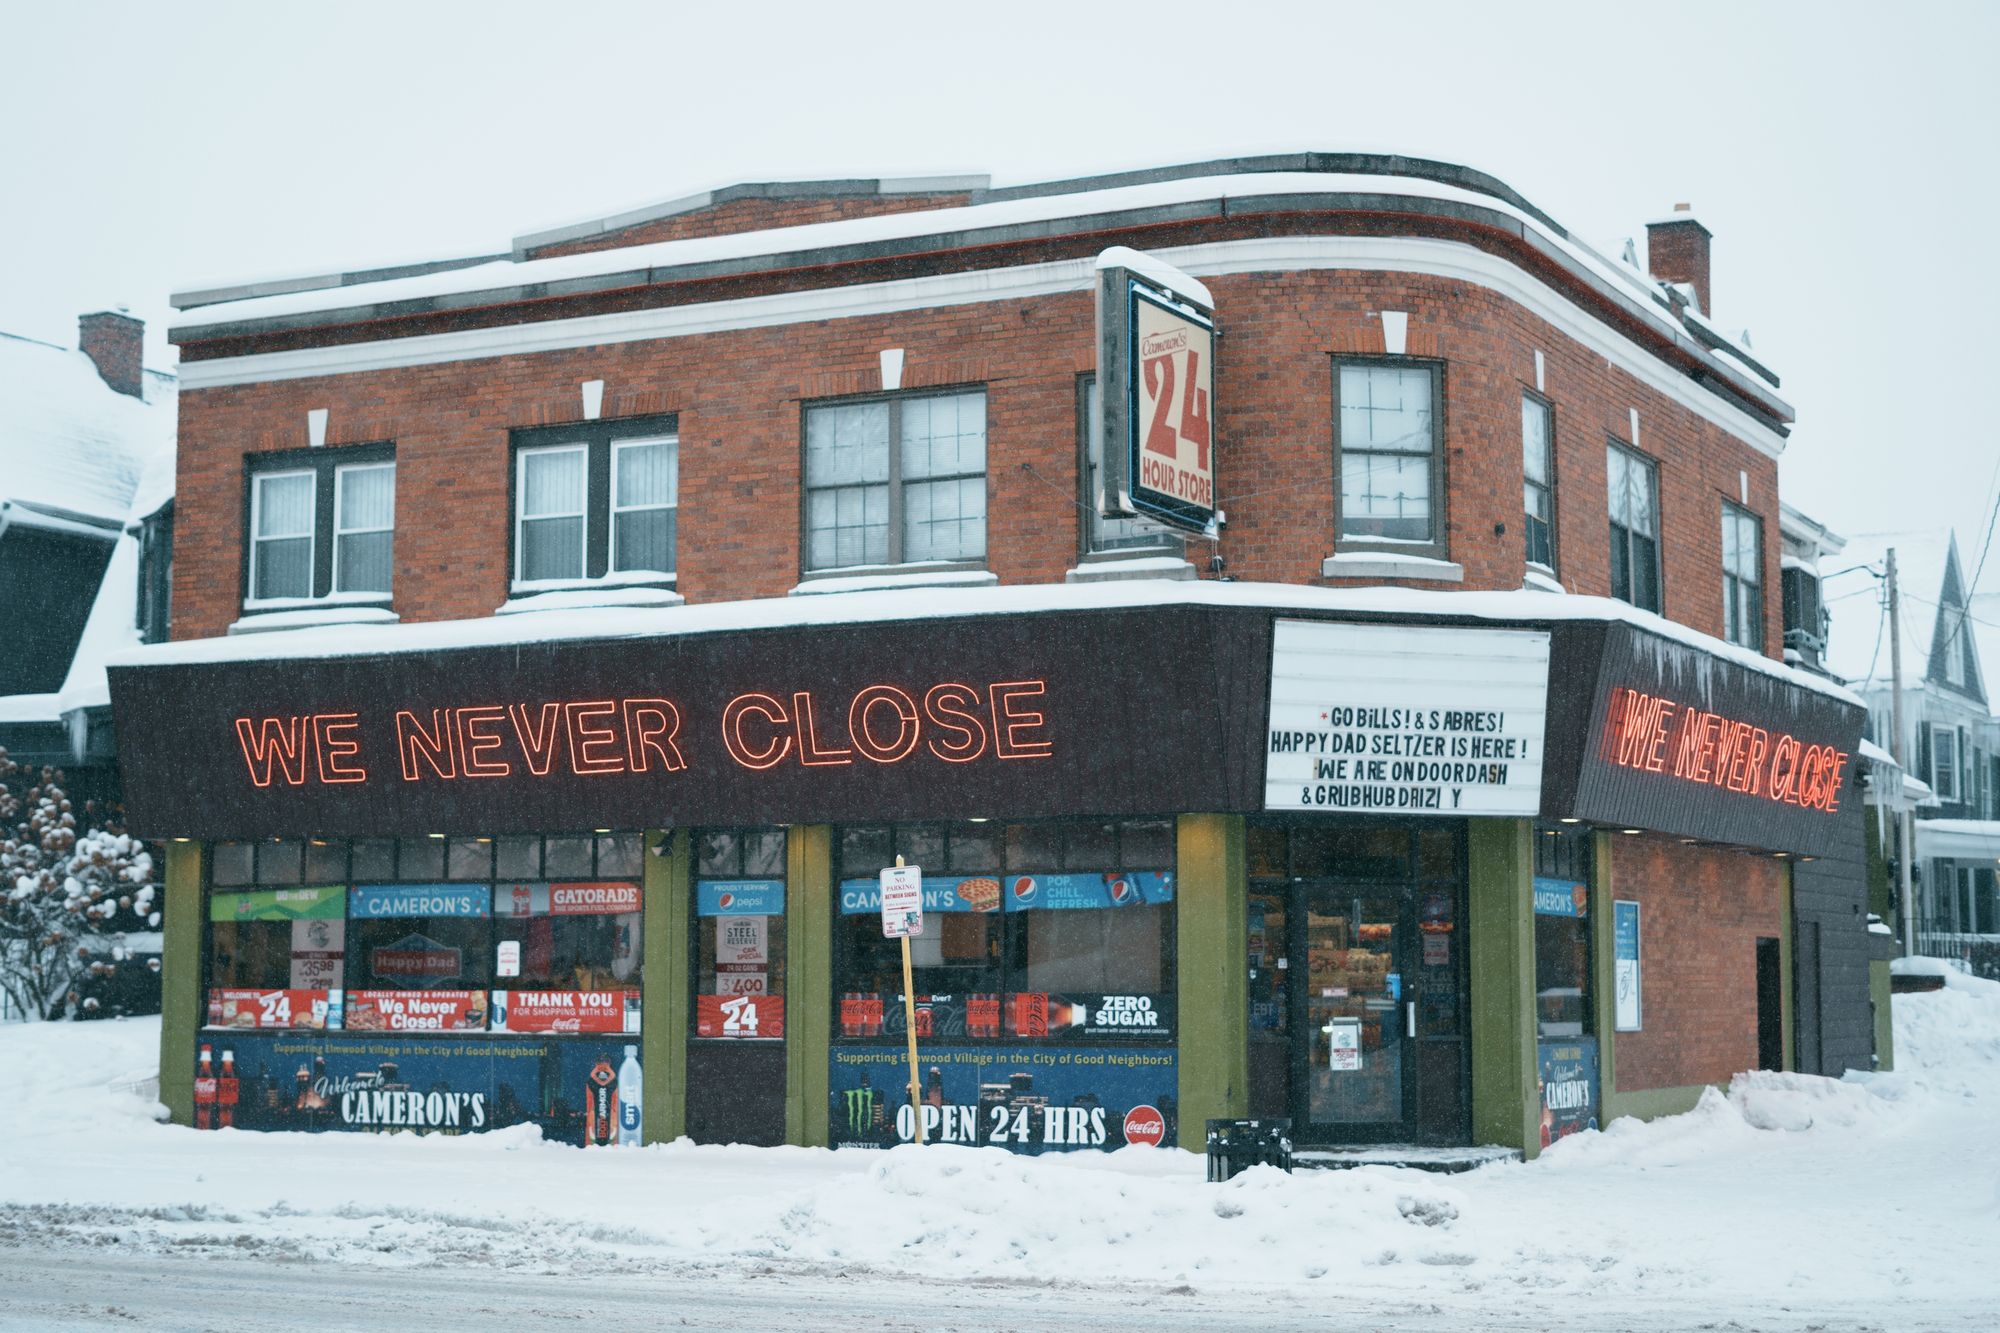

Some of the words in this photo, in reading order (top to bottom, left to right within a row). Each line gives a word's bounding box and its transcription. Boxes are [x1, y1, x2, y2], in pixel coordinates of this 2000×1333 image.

[1142, 332, 1187, 356] Cameron's
[1143, 349, 1210, 472] 24
[1143, 457, 1175, 494] HOUR
[1178, 470, 1211, 505] STORE
[1331, 707, 1354, 727] GO
[1414, 711, 1425, 730] &
[236, 712, 366, 787] WE
[396, 699, 688, 781] NEVER
[722, 681, 1053, 769] CLOSE
[1270, 731, 1328, 752] HAPPY
[1332, 732, 1367, 754] DAD
[1371, 734, 1446, 757] SELTZER
[1451, 736, 1468, 757] IS
[1618, 689, 1676, 772] WE
[1675, 707, 1768, 795] NEVER
[1769, 734, 1849, 813] CLOSE
[1318, 759, 1348, 779] WE
[1354, 760, 1388, 781] ARE
[1391, 761, 1415, 781] ON
[1417, 761, 1508, 785] DOORDASH
[1301, 787, 1311, 805] &
[1315, 785, 1396, 807] GRUBHUB
[886, 884, 915, 892] PARKING
[1047, 876, 1073, 887] POP.
[554, 888, 637, 904] GATORADE
[843, 891, 954, 909] CAMN'S
[1047, 888, 1084, 898] CHILL.
[1534, 891, 1572, 912] AMERON'S
[368, 897, 471, 914] CAMERON'S
[737, 897, 763, 908] pepsi
[727, 927, 757, 938] STEEL
[378, 956, 423, 971] Happy
[427, 956, 456, 967] Dad
[379, 999, 404, 1014] We
[408, 999, 457, 1014] Never
[519, 993, 574, 1006] THANK
[578, 993, 612, 1007] YOU
[932, 994, 952, 1002] Ever?
[1102, 996, 1152, 1011] ZERO
[260, 997, 291, 1022] 24
[513, 1007, 530, 1015] FOR
[533, 1007, 576, 1016] SHOPPING
[579, 1007, 600, 1015] WITH
[603, 1007, 617, 1016] US!
[721, 1004, 758, 1030] 24
[391, 1014, 443, 1028] Close!
[1095, 1011, 1158, 1026] SUGAR
[273, 1043, 323, 1055] Supporting
[325, 1044, 366, 1054] Elmwood
[369, 1045, 400, 1057] Village
[402, 1045, 411, 1055] in
[415, 1046, 430, 1055] the
[432, 1046, 451, 1057] City
[454, 1046, 463, 1055] of
[466, 1046, 490, 1056] Good
[494, 1047, 548, 1058] Neighbors!
[837, 1053, 897, 1065] Supporting
[954, 1052, 992, 1065] Village
[996, 1053, 1006, 1063] in
[1011, 1054, 1029, 1063] the
[1033, 1054, 1055, 1065] City
[1059, 1054, 1072, 1064] of
[1074, 1054, 1104, 1064] Good
[1108, 1055, 1172, 1067] Neighbors!
[314, 1075, 373, 1098] Welcome
[372, 1070, 385, 1088] to
[1546, 1080, 1589, 1110] CAMERON'S
[341, 1090, 485, 1127] CAMERON'S
[896, 1104, 977, 1142] OPEN
[989, 1105, 1031, 1143] 24
[1043, 1106, 1106, 1144] HRS
